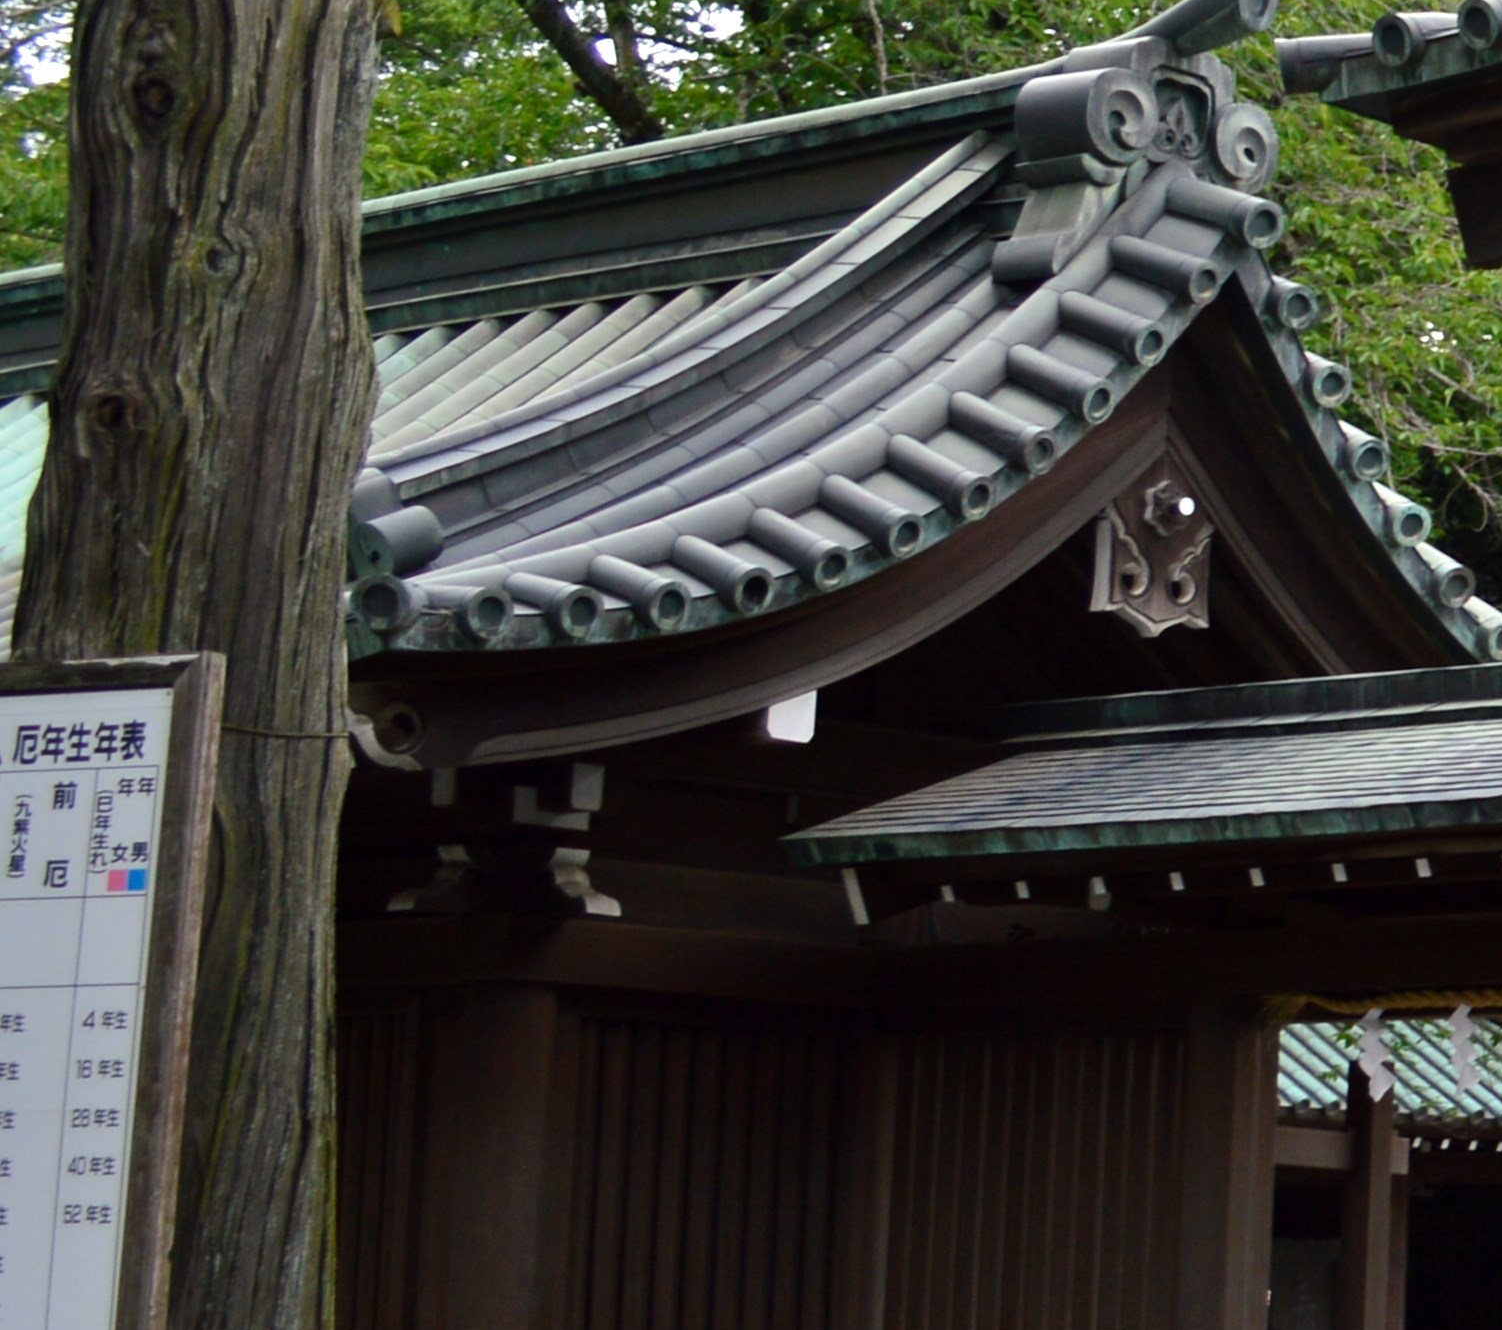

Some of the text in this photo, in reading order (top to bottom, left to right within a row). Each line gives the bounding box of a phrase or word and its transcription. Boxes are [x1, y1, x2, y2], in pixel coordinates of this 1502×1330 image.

[13, 720, 146, 765] 厄年生年表
